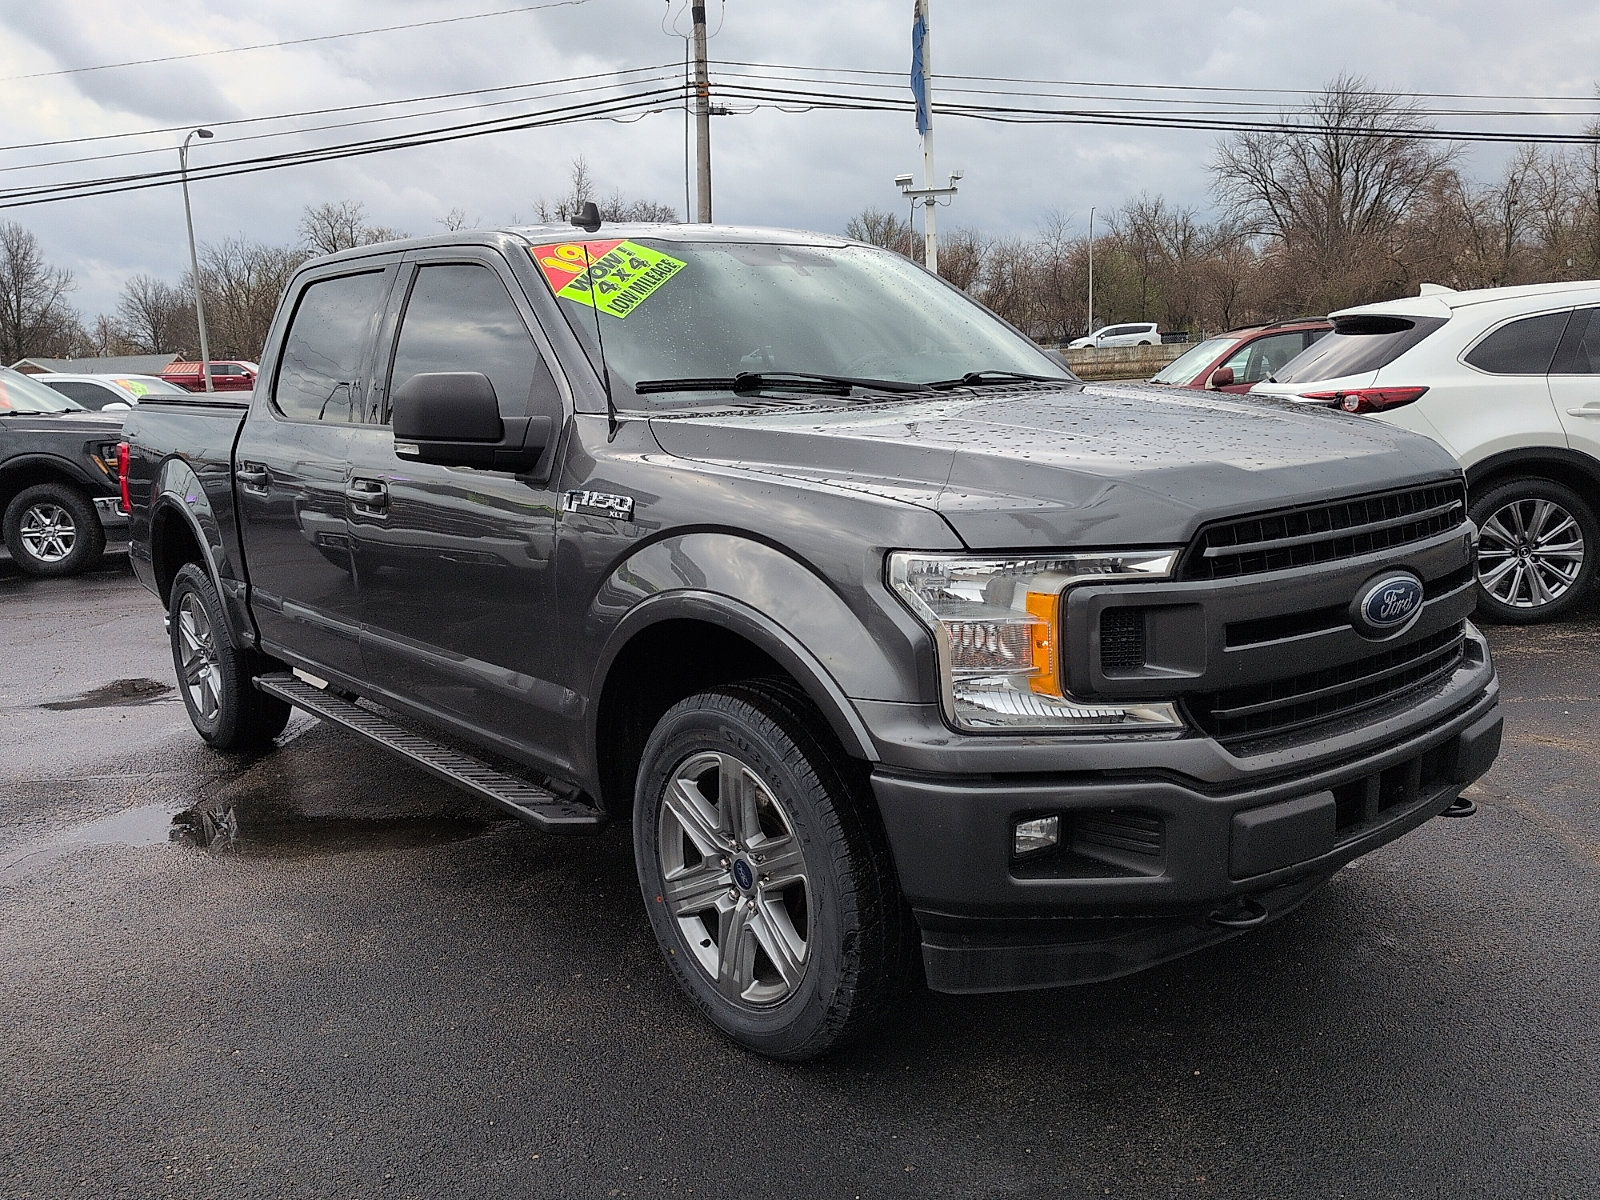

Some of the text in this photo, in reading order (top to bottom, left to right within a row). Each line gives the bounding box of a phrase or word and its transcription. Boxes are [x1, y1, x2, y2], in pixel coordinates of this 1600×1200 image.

[541, 244, 597, 273] 19
[606, 258, 681, 314] LOW MILEAGE
[1380, 587, 1414, 618] Ford
